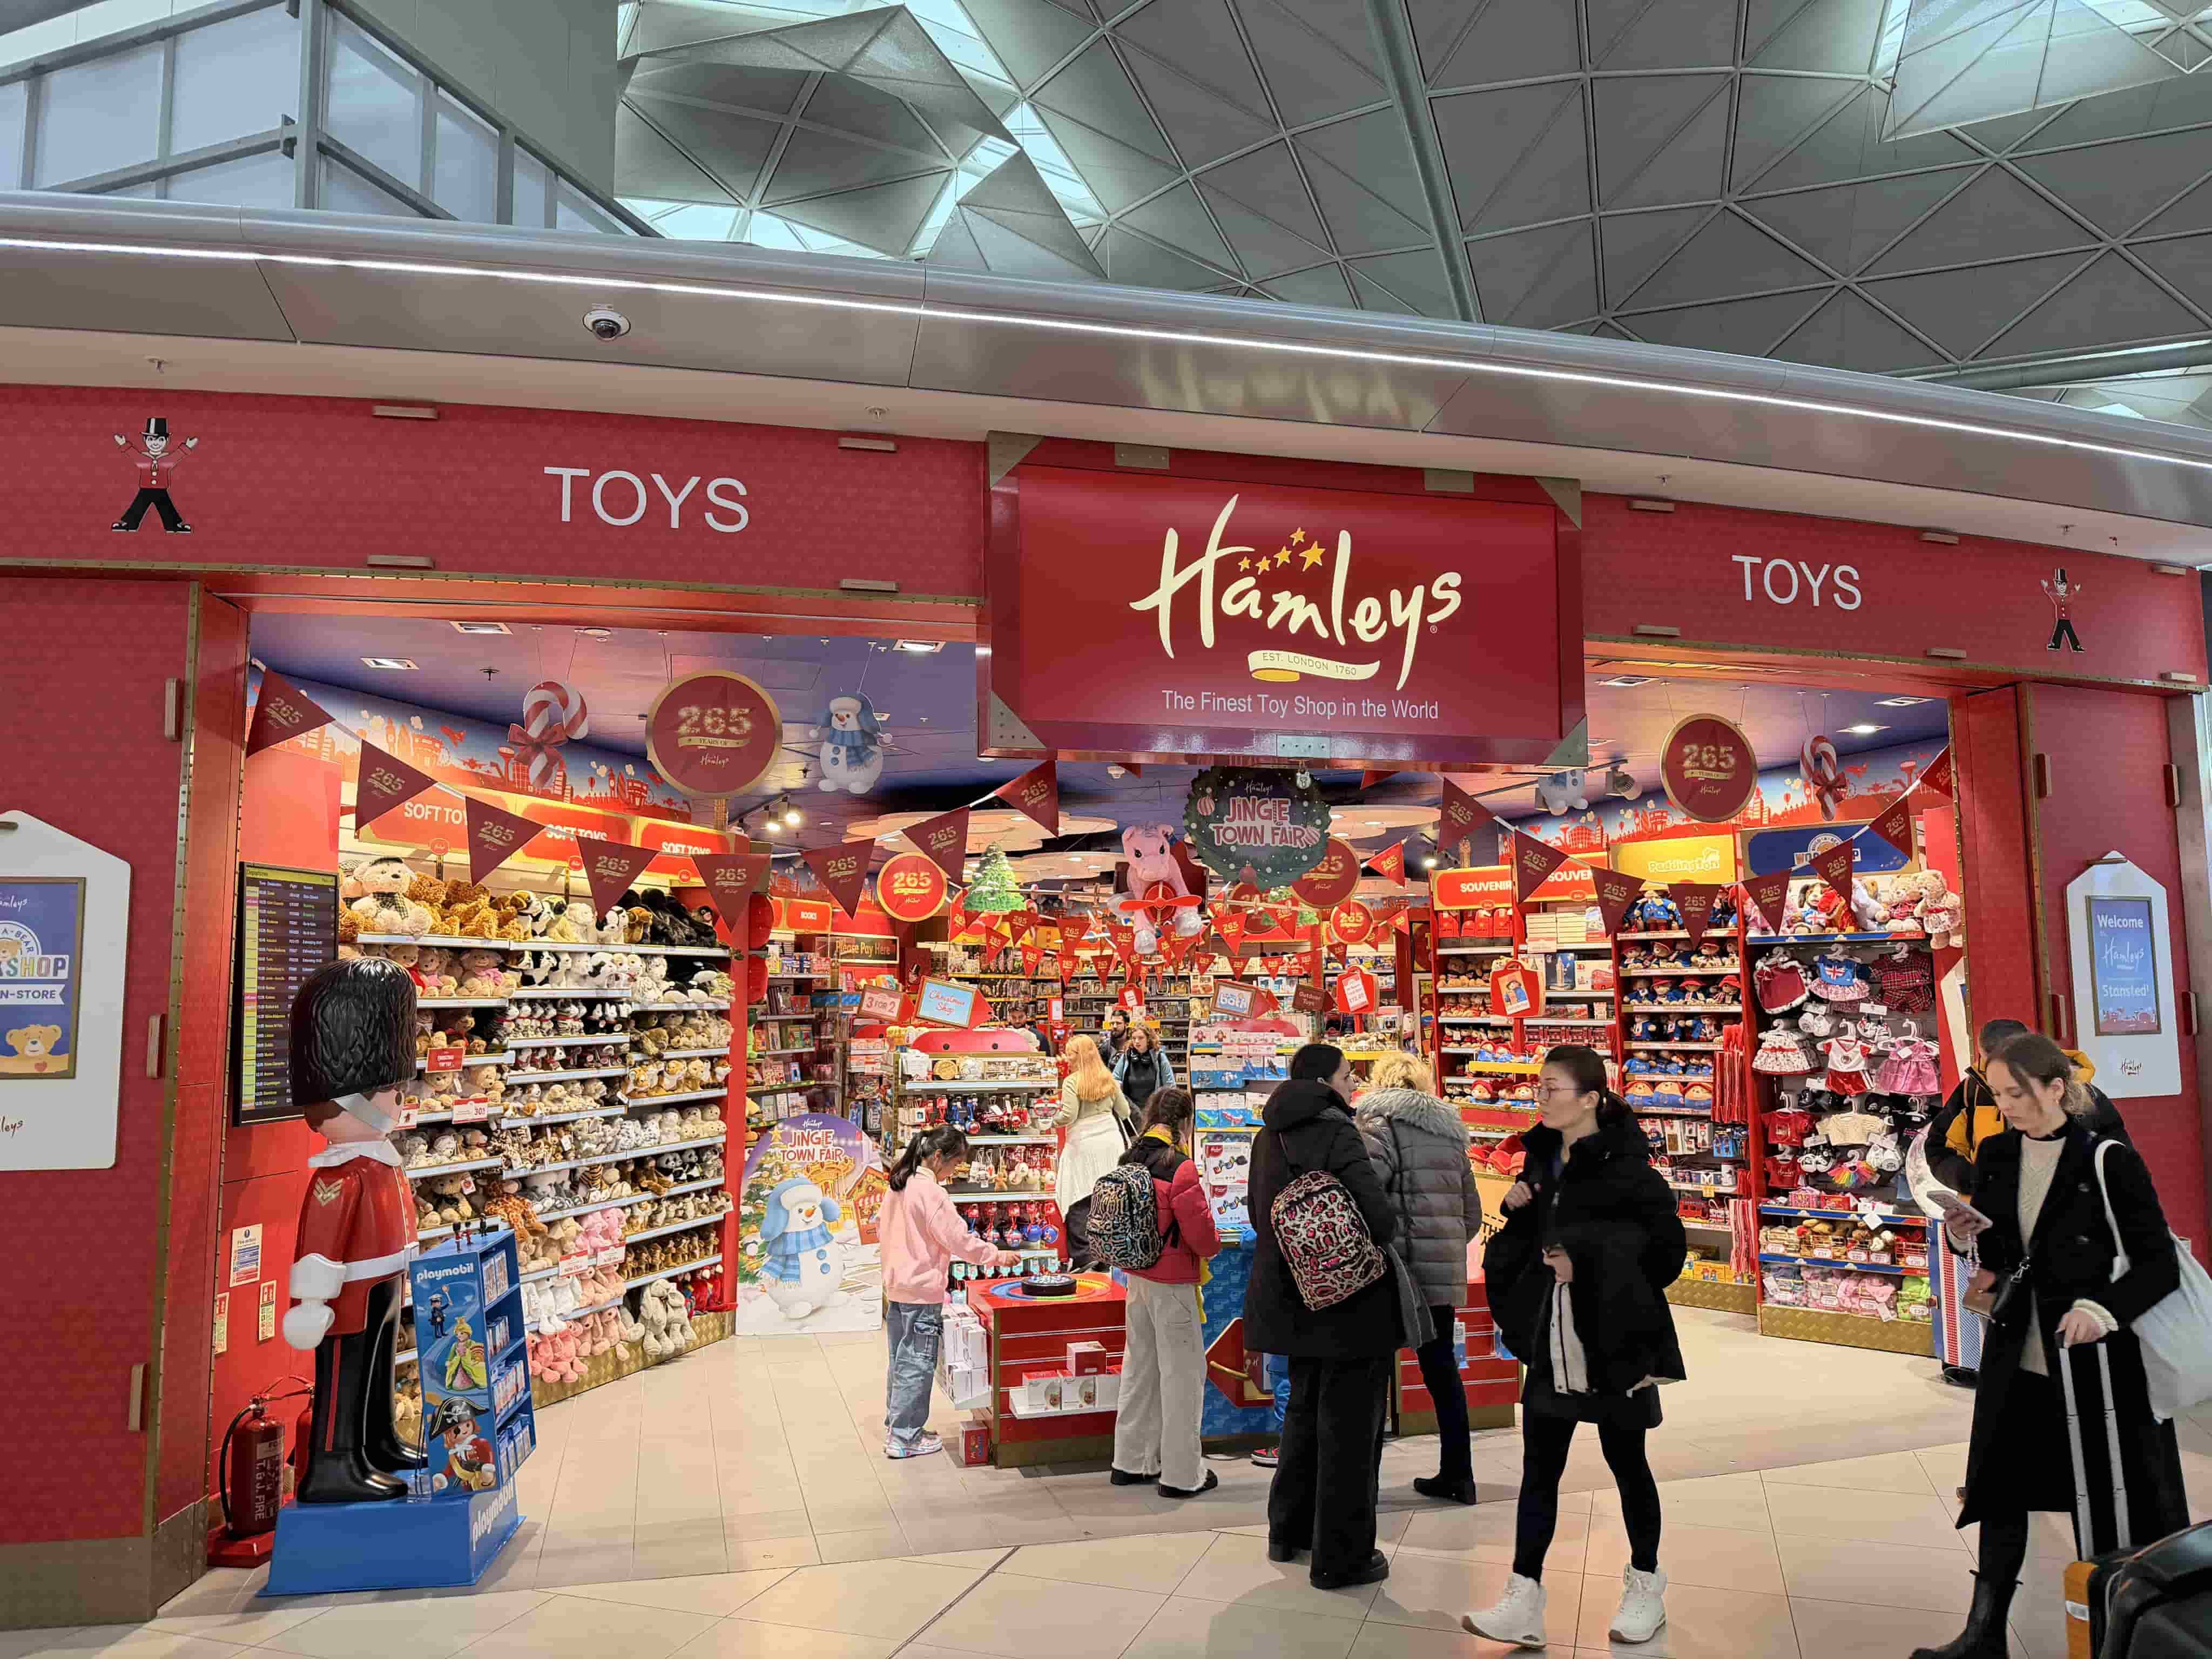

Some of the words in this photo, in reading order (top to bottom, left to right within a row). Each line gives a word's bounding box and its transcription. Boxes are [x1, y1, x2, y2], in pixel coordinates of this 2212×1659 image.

[544, 466, 749, 533] TOYS
[1129, 493, 1462, 691] Hamleys
[1731, 554, 1862, 611] TOYS
[1262, 652, 1284, 662] EST.
[1287, 654, 1328, 671] LONDON
[1334, 664, 1357, 676] 1760
[269, 697, 303, 724] 265
[1162, 690, 1195, 711] The
[1201, 691, 1253, 713] Finest
[1257, 693, 1289, 718] Toy
[1294, 696, 1337, 720] Shop
[1341, 698, 1357, 717] in
[1361, 698, 1387, 718] the
[1391, 699, 1439, 719] World
[676, 707, 752, 735] 265
[1682, 744, 1735, 768] 265
[369, 766, 407, 791] 265
[1020, 780, 1048, 802] 265
[403, 801, 439, 820] SOFT
[443, 807, 467, 825] TO
[1449, 800, 1474, 822] 265
[480, 820, 515, 842] 265
[545, 824, 576, 841] SOFT
[1886, 813, 1904, 833] 265
[927, 825, 957, 845] 265
[1213, 825, 1265, 845] TOWN
[596, 855, 631, 872] 265
[826, 857, 858, 872] 265
[1380, 855, 1398, 868] 265
[1525, 849, 1548, 870] 265
[1827, 855, 1847, 873] 265
[715, 868, 747, 881] 265
[892, 871, 932, 887] 265
[1603, 883, 1628, 898] 265
[1758, 885, 1781, 899] 265
[1684, 895, 1707, 907] 265
[1222, 921, 1239, 930] 265
[1340, 912, 1364, 923] 265
[2097, 914, 2143, 929] Welcome
[1064, 927, 1080, 935] 265
[1117, 932, 1132, 940] 265
[835, 940, 860, 955] Please
[860, 941, 874, 958] Pay
[875, 942, 891, 955] Here
[866, 996, 874, 1008] 3
[888, 1001, 896, 1014] 2
[780, 1148, 815, 1161] TOWN
[416, 1262, 474, 1282] playmobil
[255, 1494, 266, 1521] FIRE
[471, 1482, 516, 1552] playmobil
